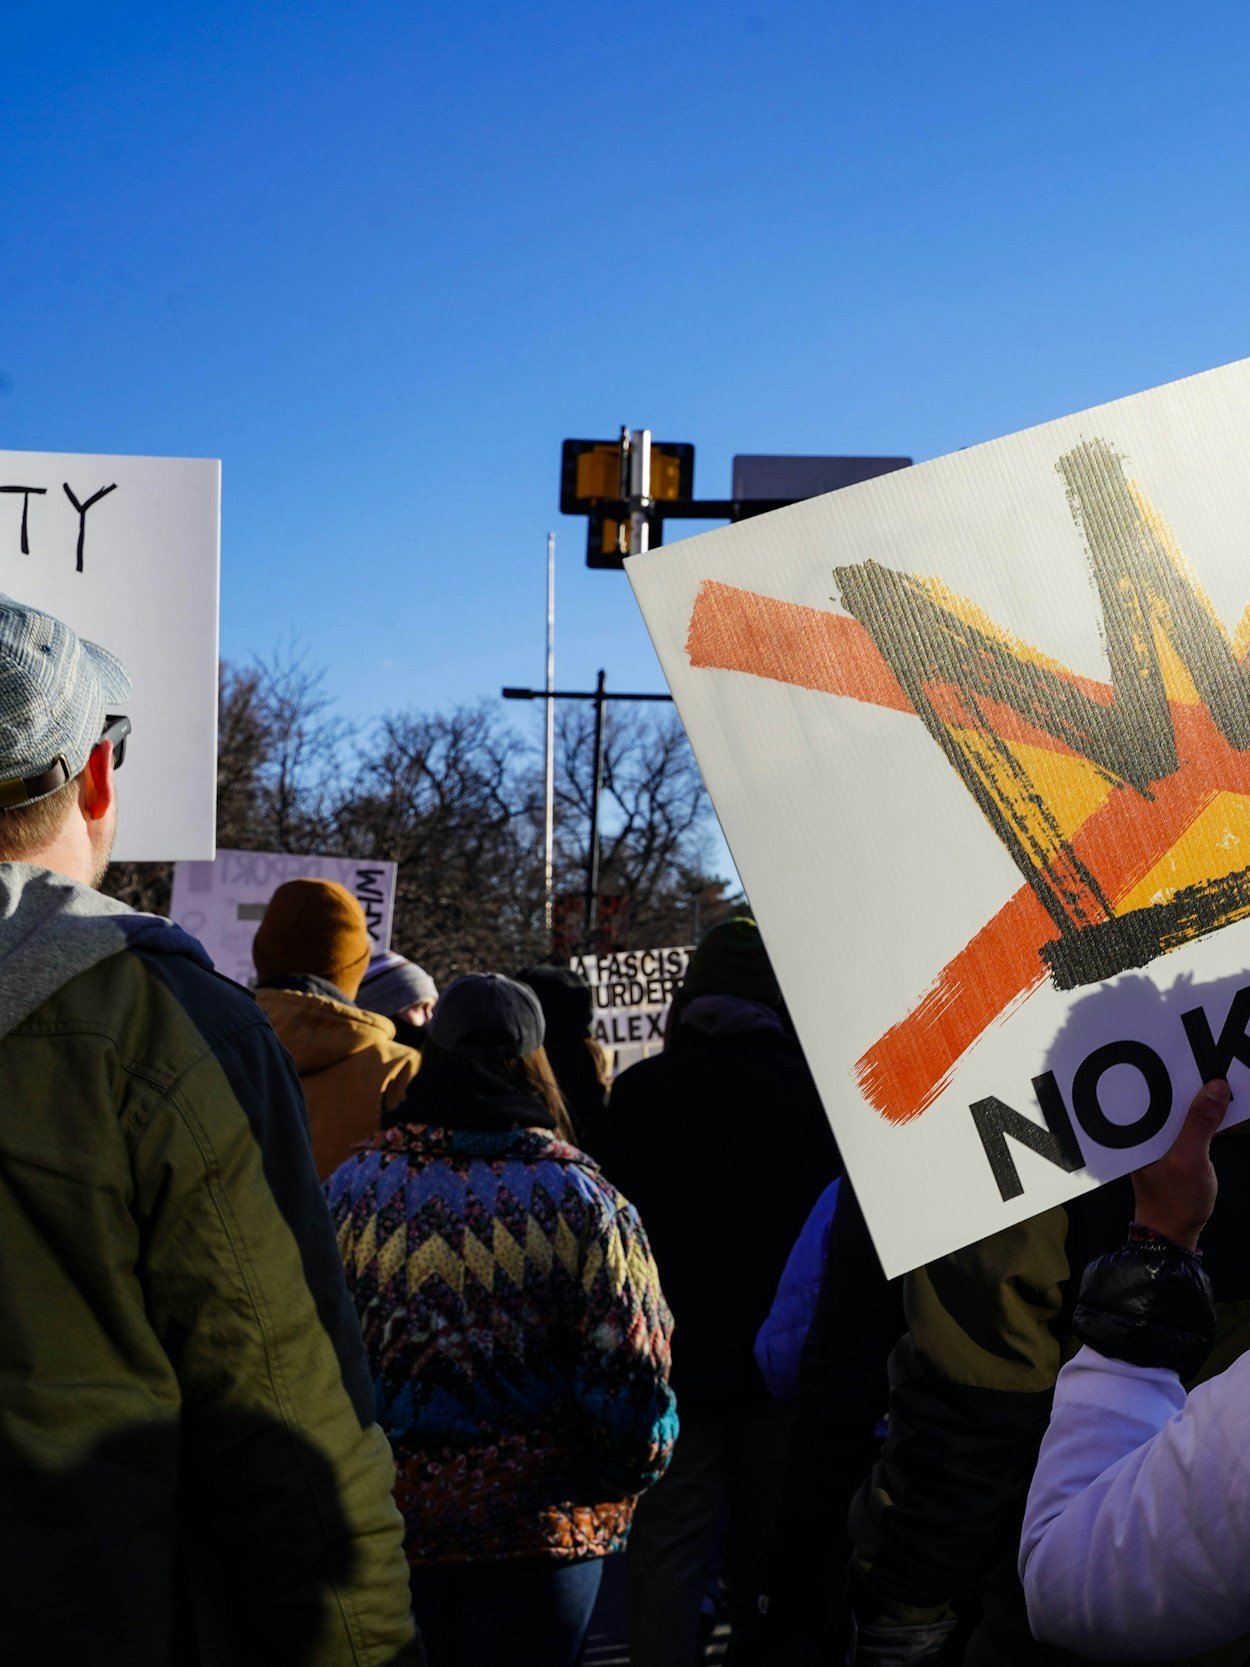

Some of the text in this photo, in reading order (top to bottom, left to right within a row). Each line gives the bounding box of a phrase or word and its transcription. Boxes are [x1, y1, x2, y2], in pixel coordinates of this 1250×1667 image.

[597, 950, 694, 984] FASCIS
[591, 977, 684, 1009] URDER
[594, 1013, 665, 1044] ALEX
[968, 1040, 1173, 1202] NO
